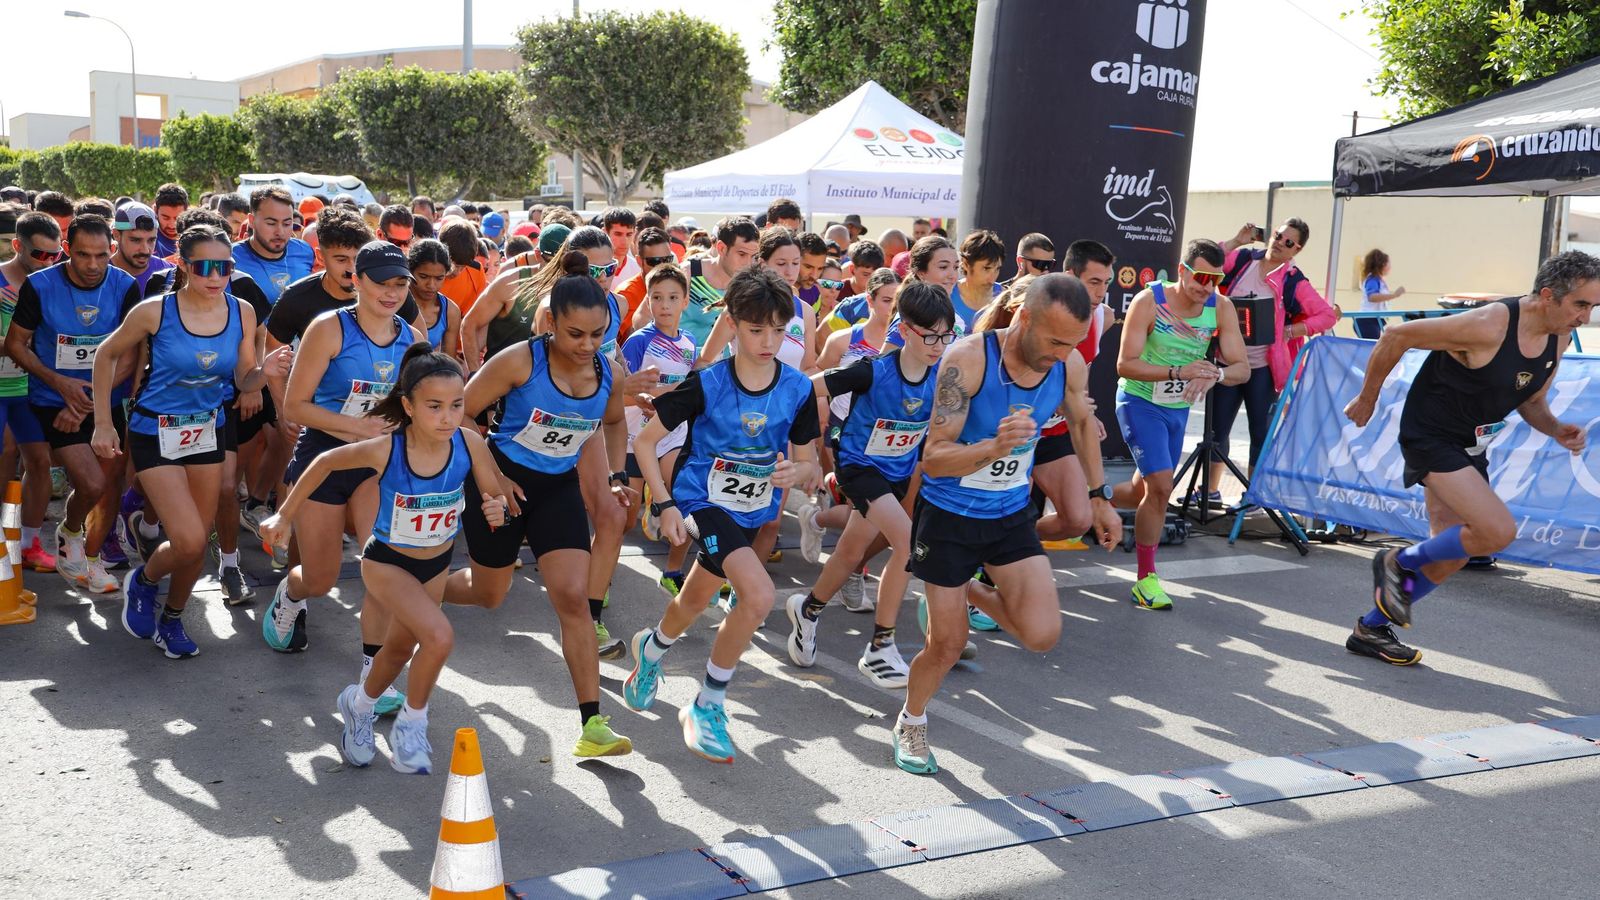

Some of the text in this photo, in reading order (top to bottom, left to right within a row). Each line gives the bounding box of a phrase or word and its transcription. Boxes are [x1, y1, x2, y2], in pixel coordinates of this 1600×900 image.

[1091, 54, 1198, 95] cajamar
[1157, 90, 1195, 108] CAJA RURA
[864, 144, 902, 157] EL
[1103, 166, 1155, 197] imd
[725, 186, 731, 197] de
[731, 185, 759, 200] Deportes
[760, 184, 768, 197] de
[769, 183, 778, 197] El
[778, 184, 796, 199] Ejido
[826, 184, 957, 204] Instituto Municipal de
[1117, 223, 1142, 232] Instituto
[1144, 226, 1168, 236] Municipal
[1125, 232, 1149, 241] Deportes
[1150, 233, 1156, 241] de
[1164, 380, 1189, 393] 23
[180, 428, 204, 446] 27
[542, 431, 574, 447] 84
[990, 460, 1019, 476] 99
[721, 477, 768, 498] 243
[1315, 479, 1399, 514] Instituto
[410, 509, 457, 532] 176
[1532, 519, 1563, 545] de
